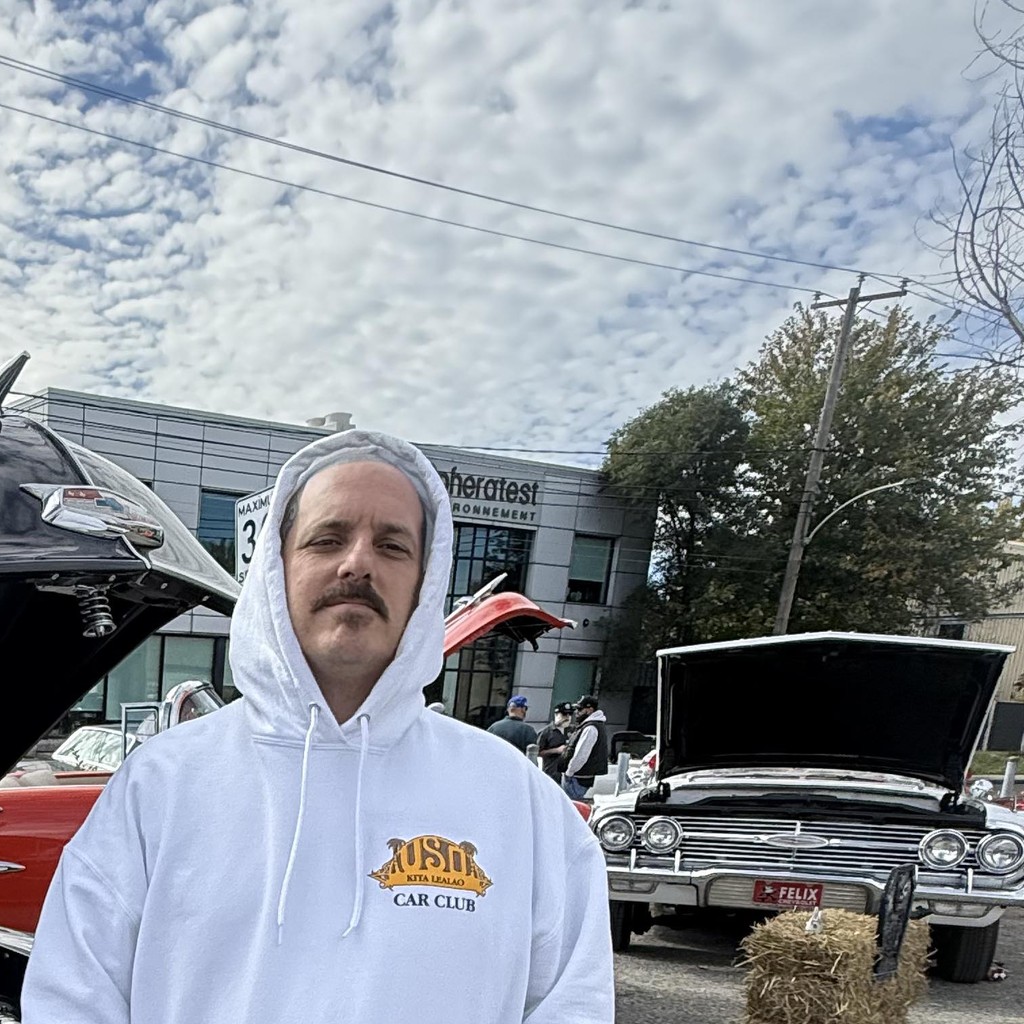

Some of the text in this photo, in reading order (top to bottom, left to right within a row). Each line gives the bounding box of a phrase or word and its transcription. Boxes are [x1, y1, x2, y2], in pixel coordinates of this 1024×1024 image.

[433, 463, 539, 506] heratest
[452, 502, 537, 521] RONNEMENT
[407, 874, 465, 886] KITA LEALAO
[393, 893, 476, 912] CAR CLUB
[779, 887, 818, 901] FELIX
